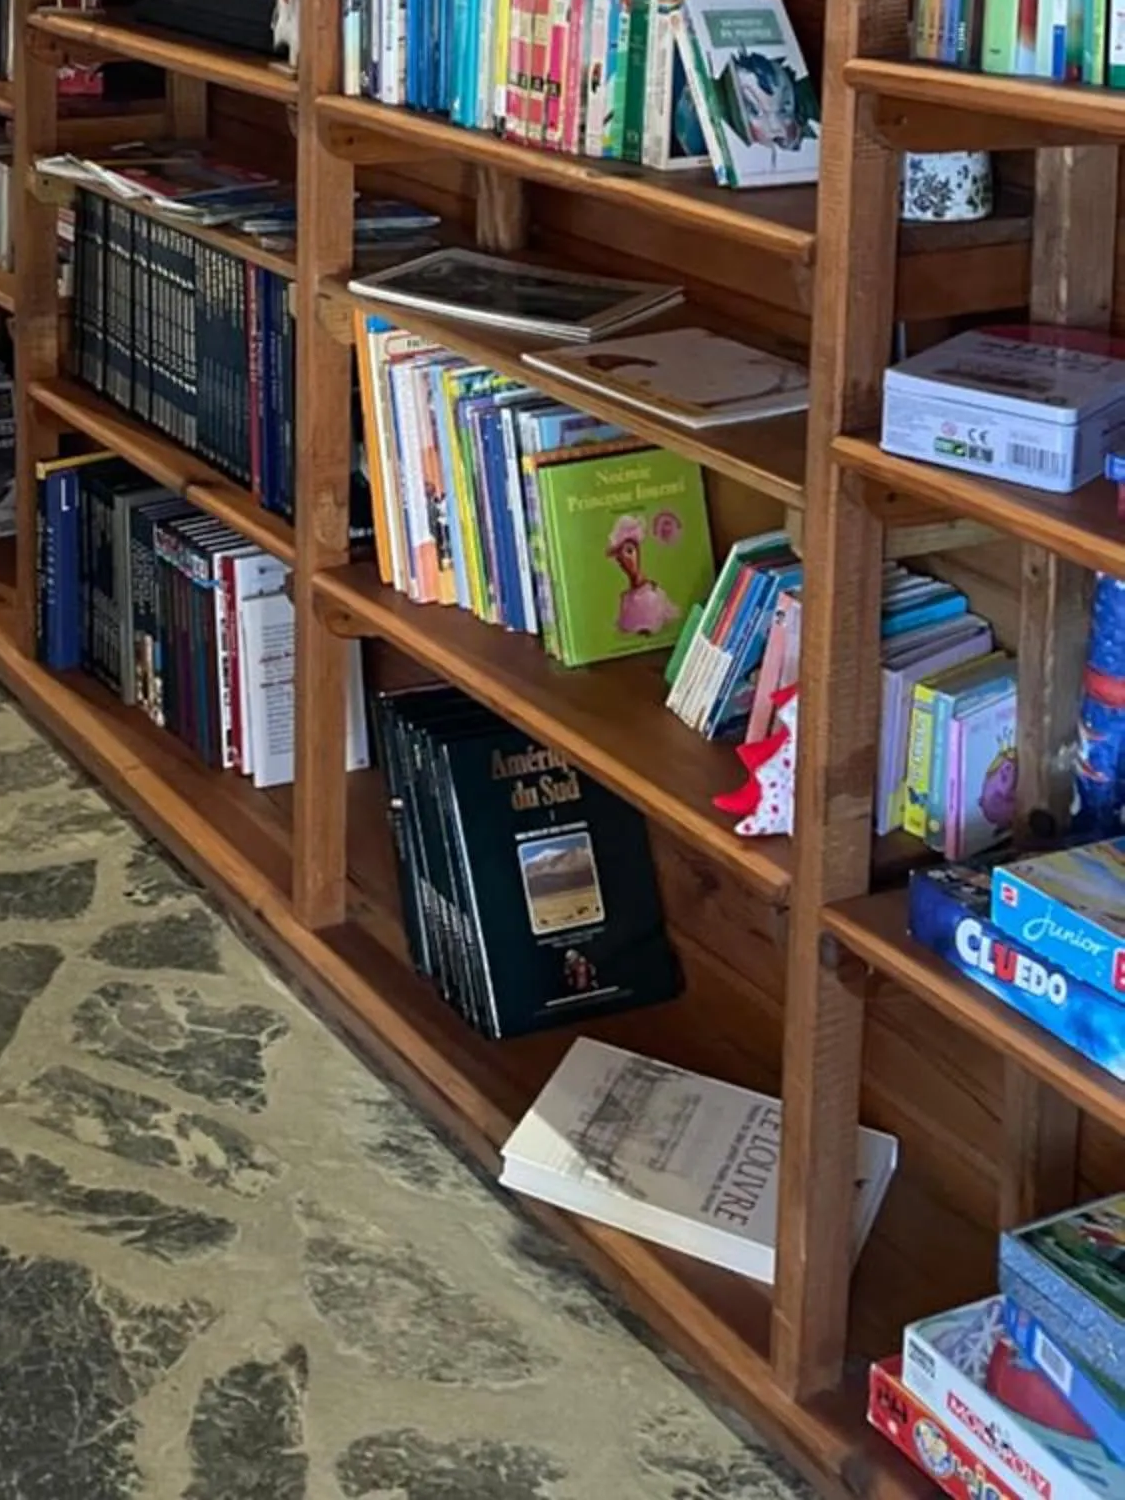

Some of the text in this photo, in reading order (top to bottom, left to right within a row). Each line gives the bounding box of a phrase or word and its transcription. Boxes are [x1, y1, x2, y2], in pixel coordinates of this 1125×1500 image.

[491, 744, 571, 780] Amériq
[511, 771, 581, 811] du Sud
[955, 918, 1068, 1005] CLUEDO
[761, 1107, 781, 1132] LE
[713, 1135, 780, 1227] LOUVRE
